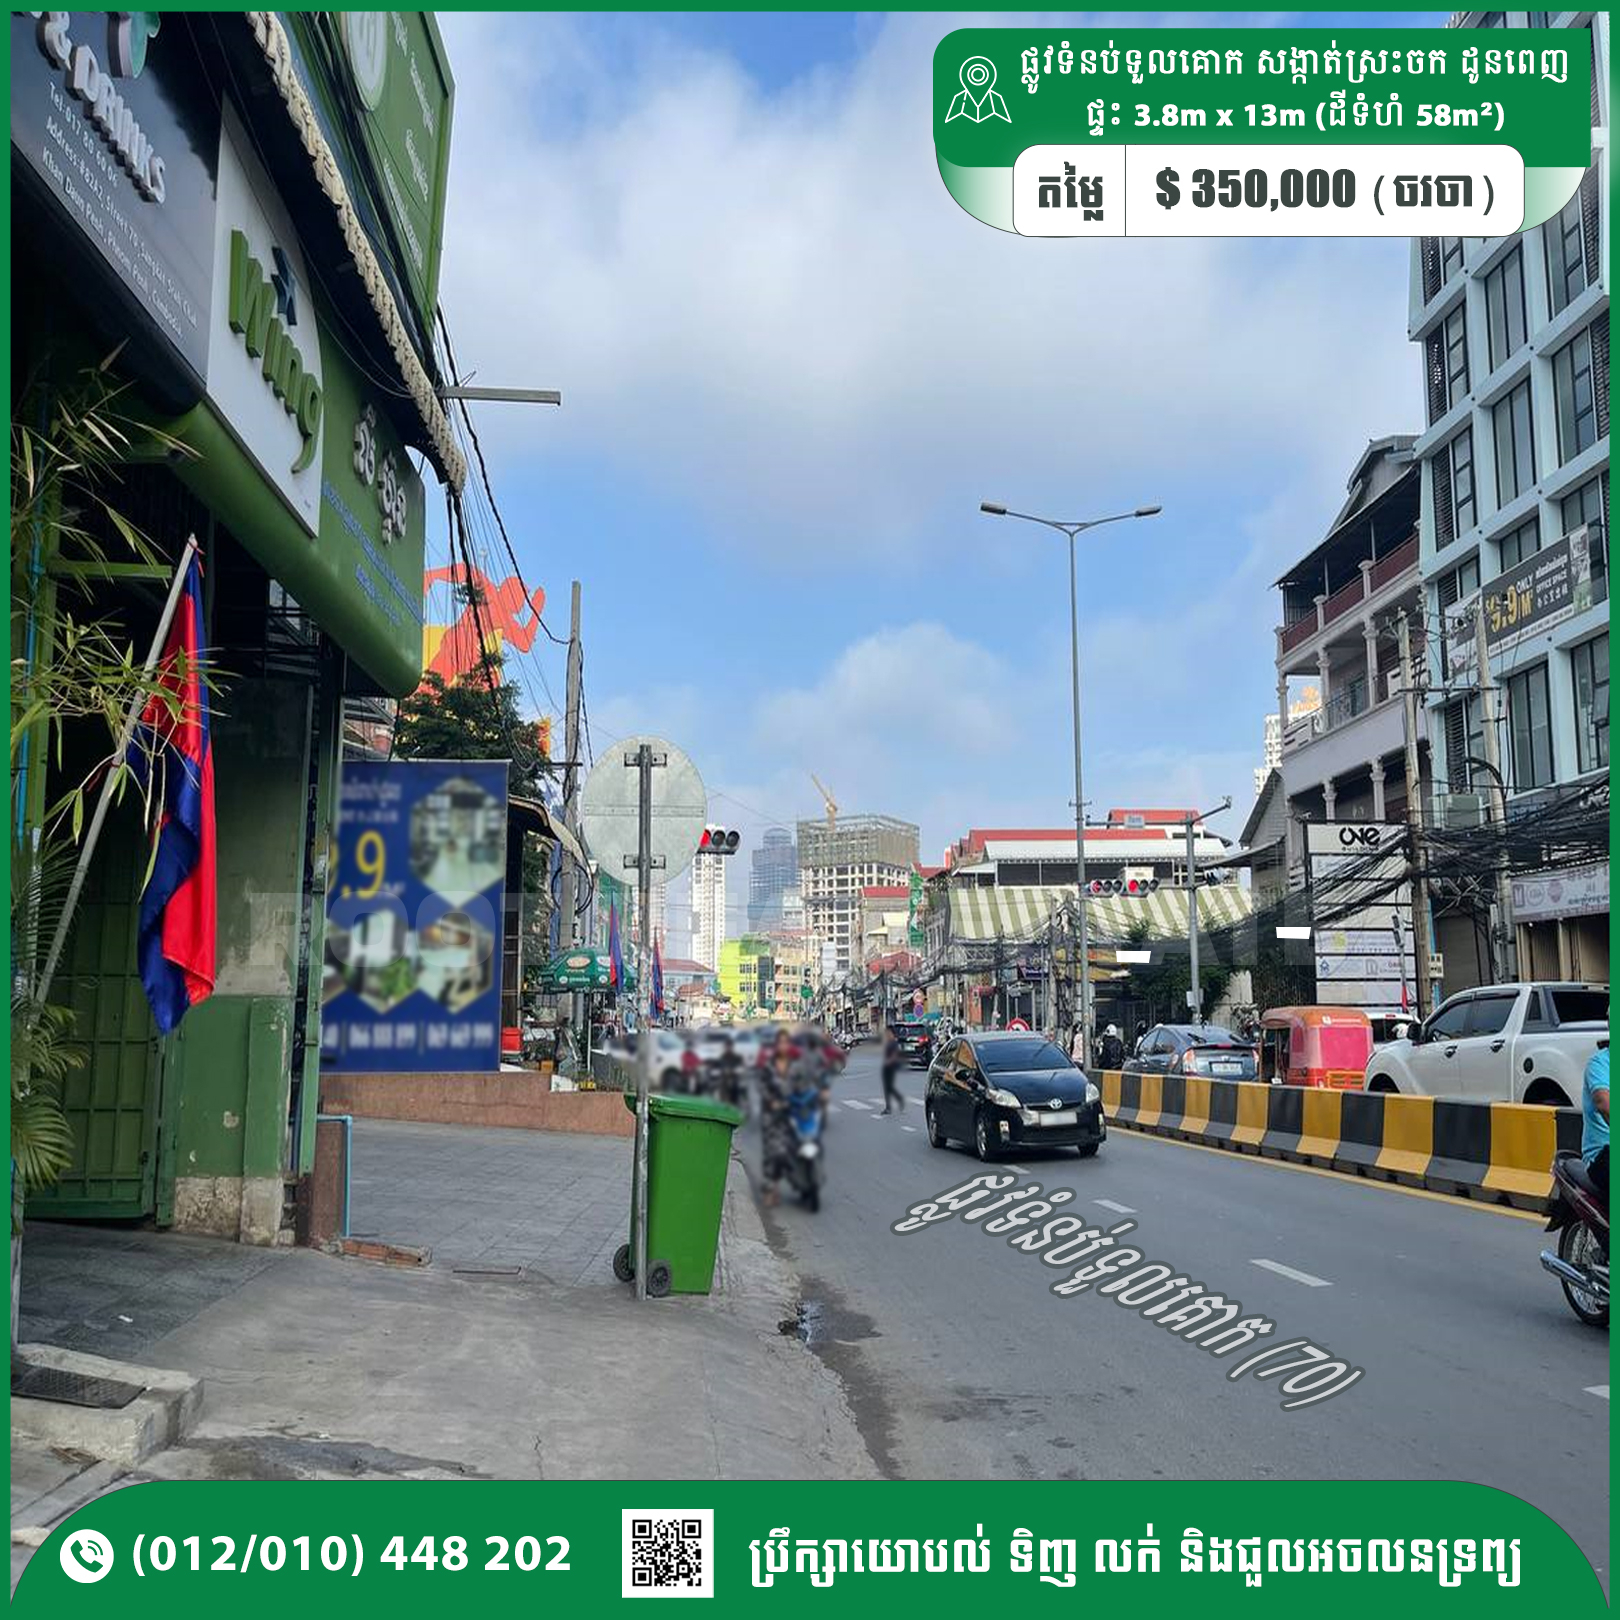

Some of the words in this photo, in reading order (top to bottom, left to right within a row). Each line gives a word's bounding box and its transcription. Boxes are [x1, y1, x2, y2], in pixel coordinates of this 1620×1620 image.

[73, 44, 166, 204] DRINKS
[229, 229, 324, 475] Wing
[1515, 573, 1534, 594] ONLY
